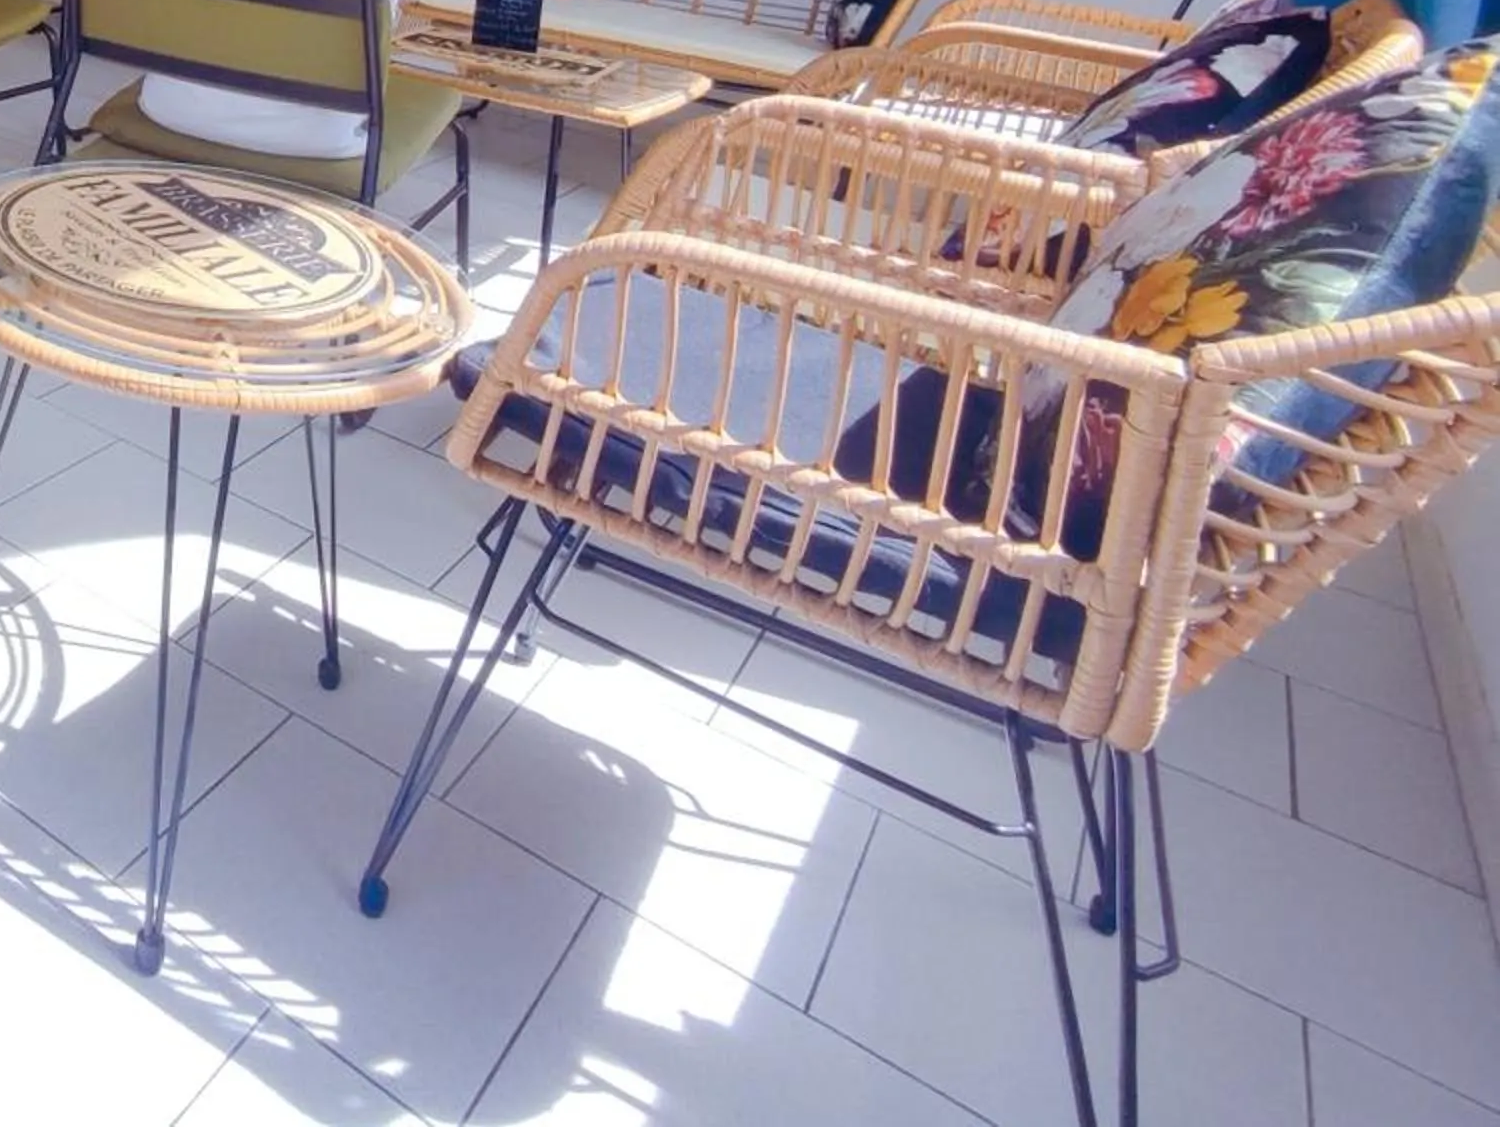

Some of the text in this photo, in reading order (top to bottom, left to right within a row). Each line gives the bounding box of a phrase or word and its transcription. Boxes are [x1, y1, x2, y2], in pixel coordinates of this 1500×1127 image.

[64, 179, 311, 306] FAMILIALE
[153, 184, 331, 275] BRASSERIE
[58, 262, 165, 299] PARTAGER
